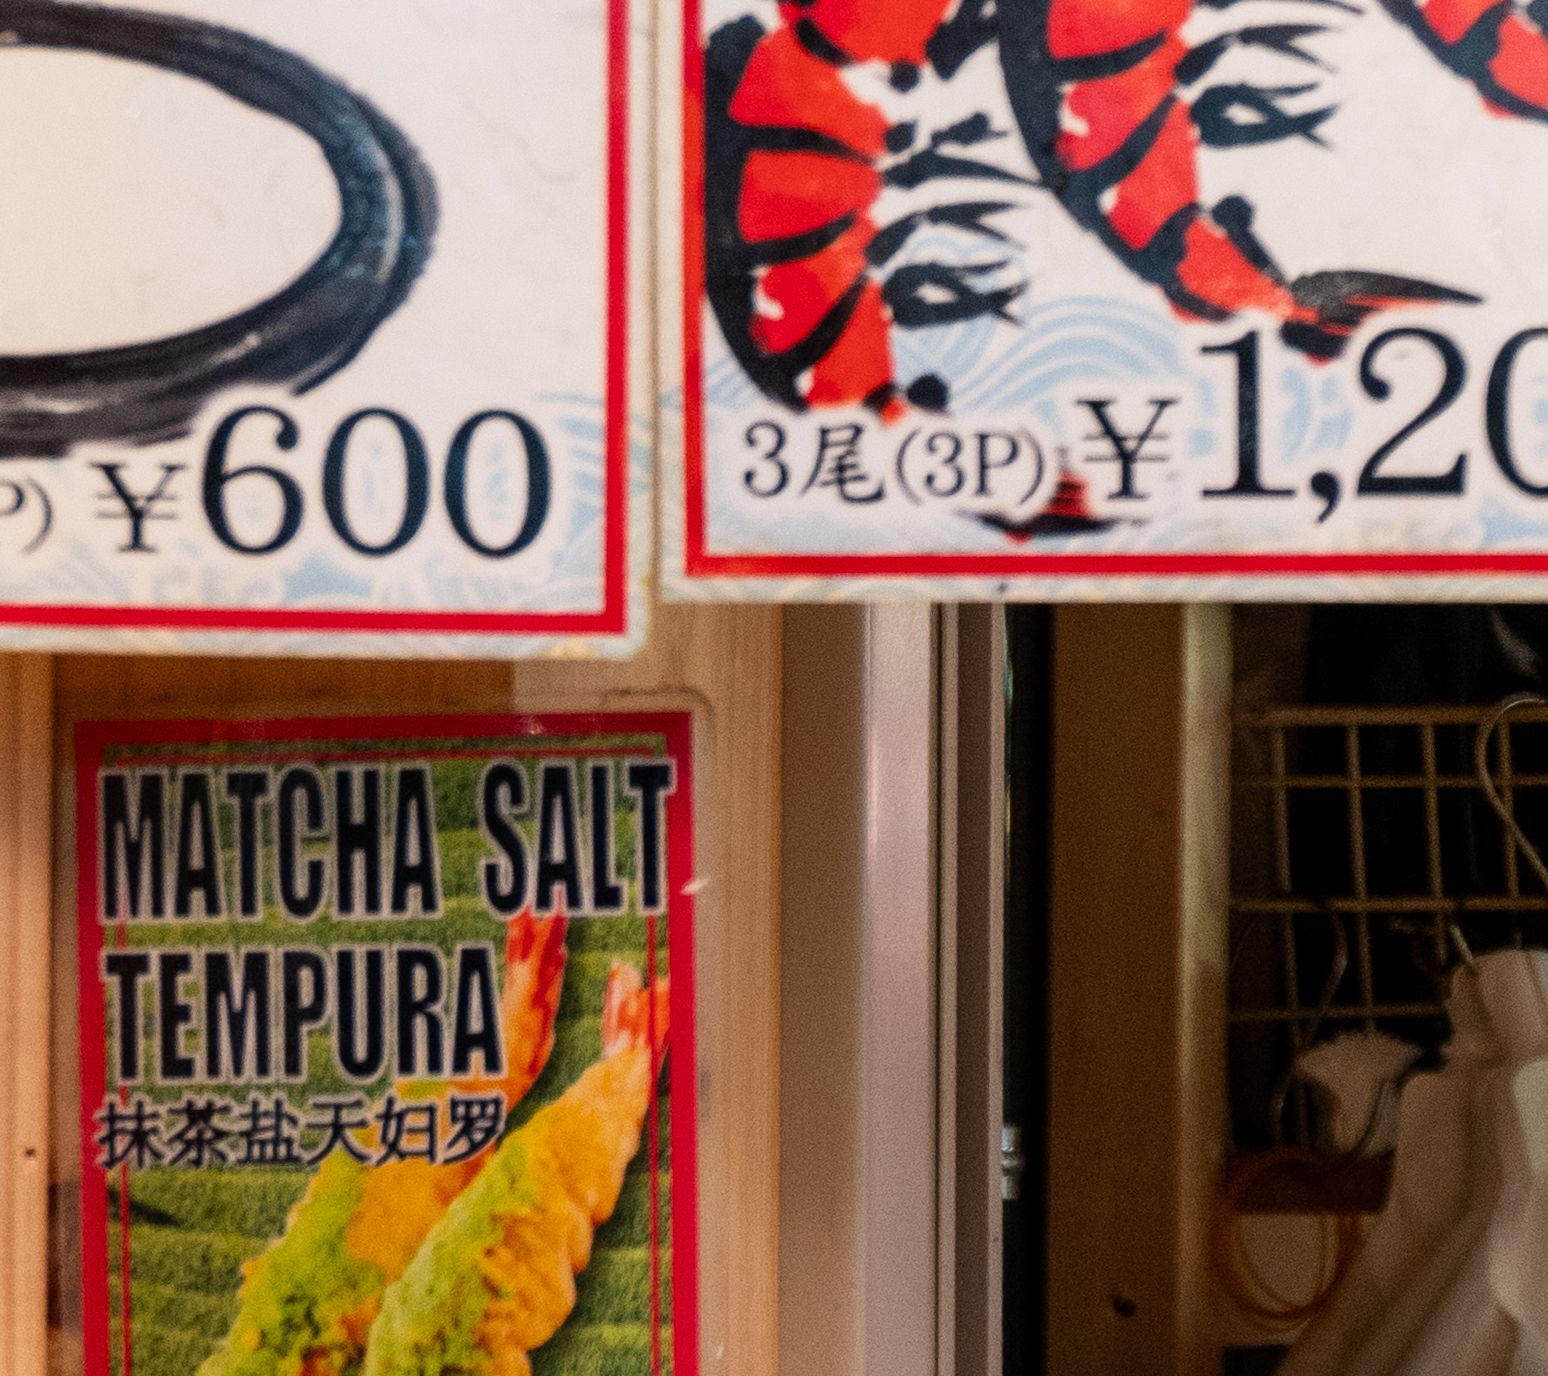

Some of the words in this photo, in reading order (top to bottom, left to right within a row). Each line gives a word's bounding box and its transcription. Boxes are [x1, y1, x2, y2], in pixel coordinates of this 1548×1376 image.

[89, 404, 554, 557] ¥600
[738, 416, 1049, 513] 3尾(3P)
[100, 765, 440, 920] MATCHA
[481, 762, 672, 915] SALT
[105, 946, 503, 1081] TEMPURA
[98, 1096, 505, 1169] 抹茶盐天妇罗
